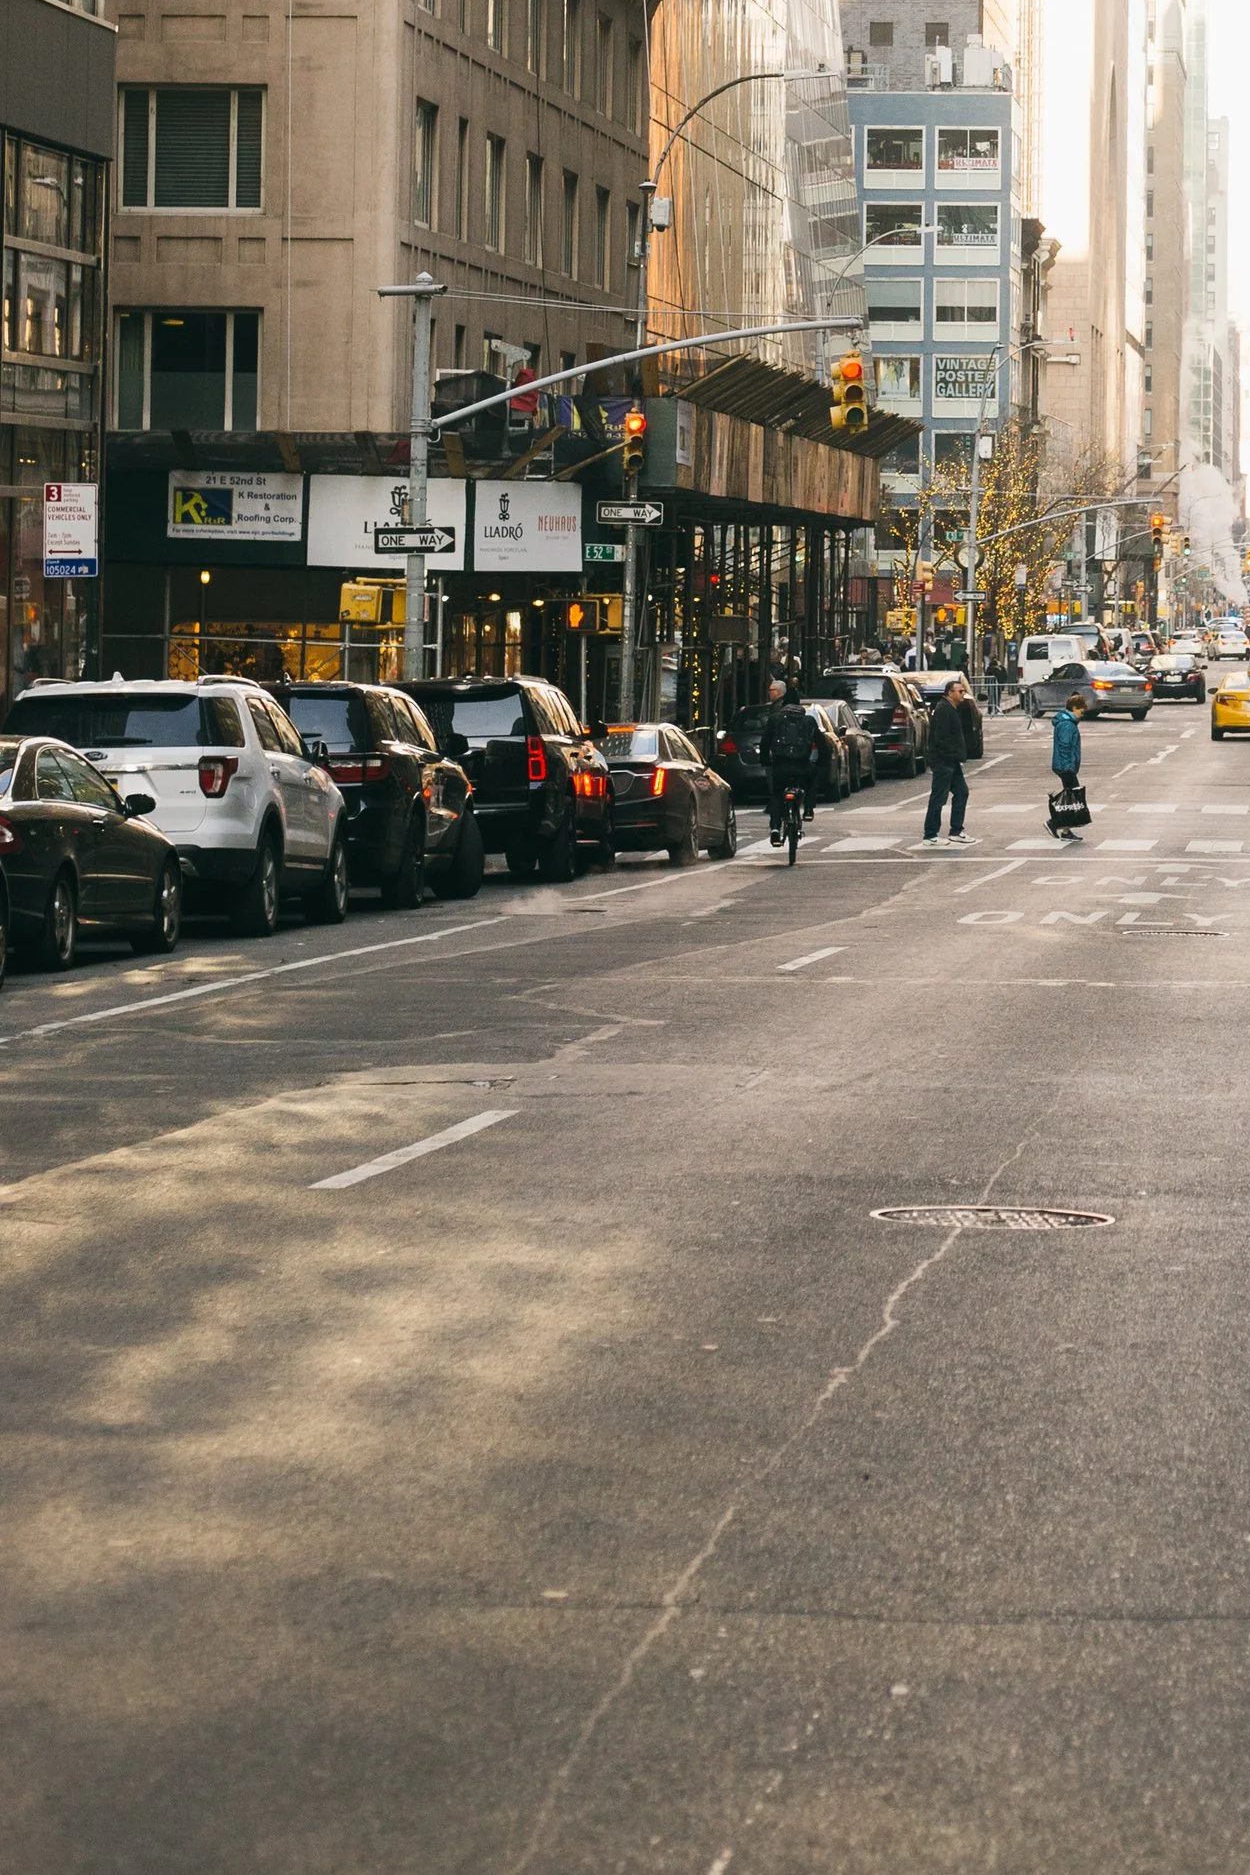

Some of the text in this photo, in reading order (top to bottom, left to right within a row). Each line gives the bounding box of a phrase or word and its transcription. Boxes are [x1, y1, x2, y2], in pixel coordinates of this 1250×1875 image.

[937, 359, 995, 370] VINTAGE
[936, 382, 994, 397] GALLERY
[206, 476, 267, 486] 21 E 52nd St
[49, 486, 58, 501] 3
[238, 491, 297, 501] K Restoration
[47, 505, 86, 513] COMMERCIAL
[263, 503, 271, 511] &
[76, 514, 93, 522] ONLY
[603, 508, 654, 518] ONE WAY
[237, 514, 271, 524] Roofing
[538, 515, 577, 533] NEUHAUS
[484, 522, 524, 541] LLADRÓ
[381, 535, 406, 547] ONE
[419, 535, 445, 546] WAY
[585, 546, 591, 558] E
[592, 545, 603, 559] 52
[46, 565, 76, 575] 105024
[956, 910, 1235, 927] ONLY
